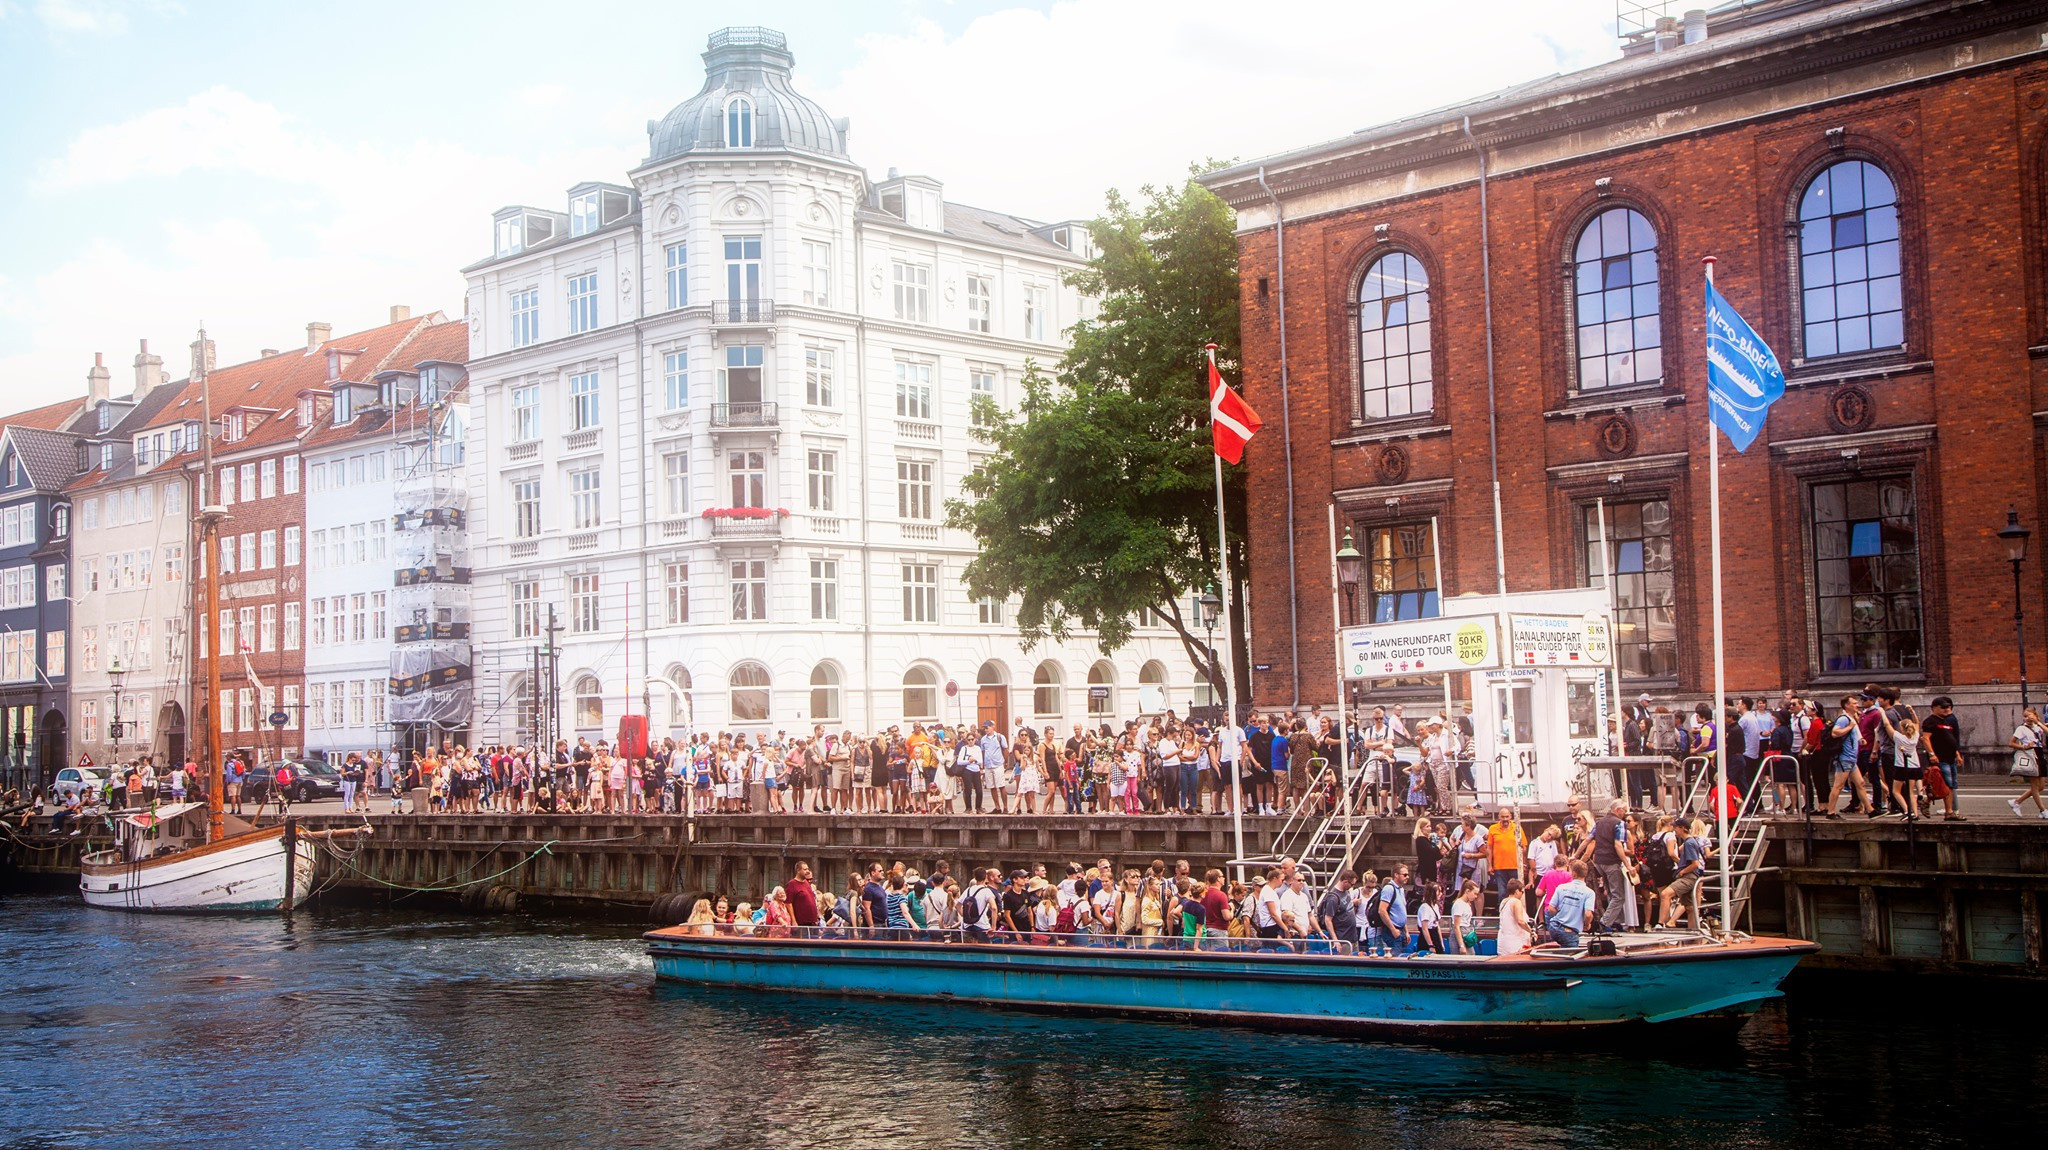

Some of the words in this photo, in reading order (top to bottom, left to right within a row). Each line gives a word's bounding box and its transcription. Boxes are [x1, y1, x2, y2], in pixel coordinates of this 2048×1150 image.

[1588, 626, 1595, 635] 50
[1595, 626, 1605, 635] KR
[1373, 633, 1452, 648] HAVNERUNDFART
[1459, 636, 1469, 646] 50
[1470, 635, 1483, 644] KR
[1514, 631, 1581, 642] KANALRUNDFART
[1515, 642, 1522, 651] 60
[1538, 642, 1563, 651] GUIDED
[1564, 642, 1582, 652] TOUR
[1588, 642, 1595, 651] 20
[1596, 642, 1606, 651] KR
[1358, 652, 1369, 662] 60
[1371, 650, 1389, 661] MIN.
[1391, 647, 1425, 659] GUIDED
[1428, 645, 1453, 657] TOUR
[1460, 650, 1470, 659] 20
[1471, 649, 1484, 658] KR
